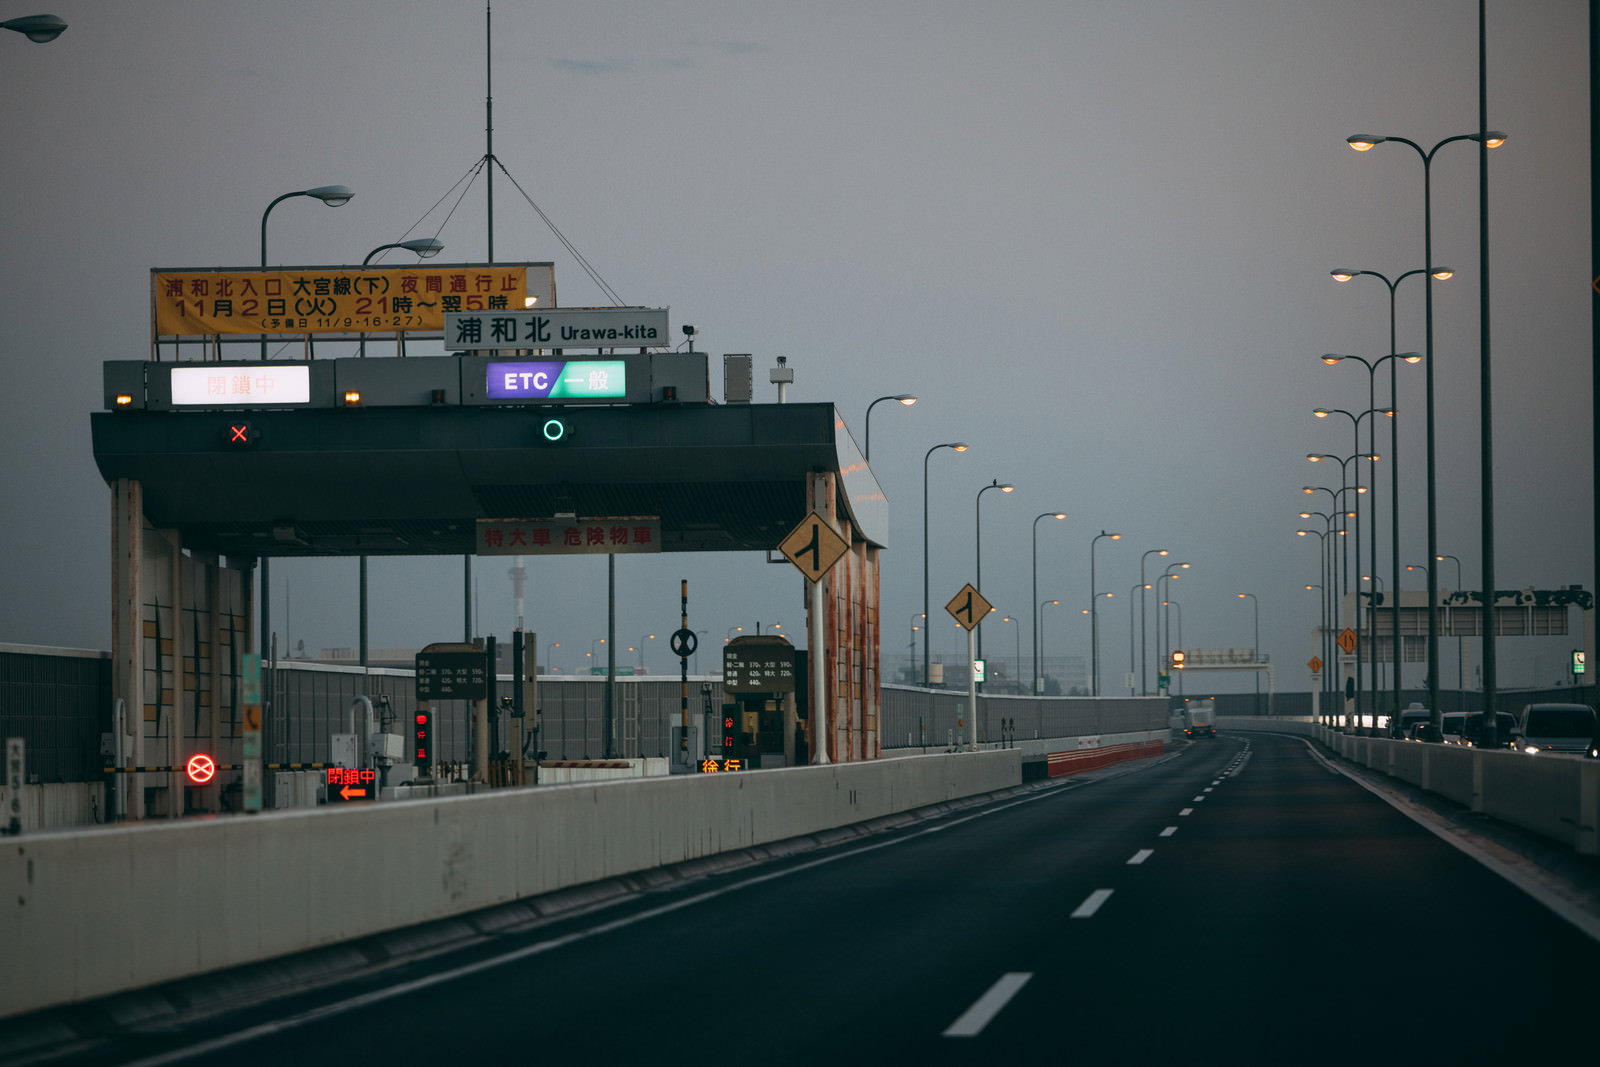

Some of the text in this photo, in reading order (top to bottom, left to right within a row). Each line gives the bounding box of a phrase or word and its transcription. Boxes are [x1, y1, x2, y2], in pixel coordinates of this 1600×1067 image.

[165, 273, 518, 297] 浦和北入口 大宮線(下) 夜間通行止
[175, 297, 337, 318] 11月2日(火)
[456, 316, 658, 344] 浦和北 Urawa-kita
[207, 375, 275, 395] 閉鎖中
[504, 369, 610, 391] ETC 一般
[484, 525, 653, 547] 特大車 危険物車
[327, 768, 375, 785] 閉鎖中
[702, 759, 741, 773] 徐行
